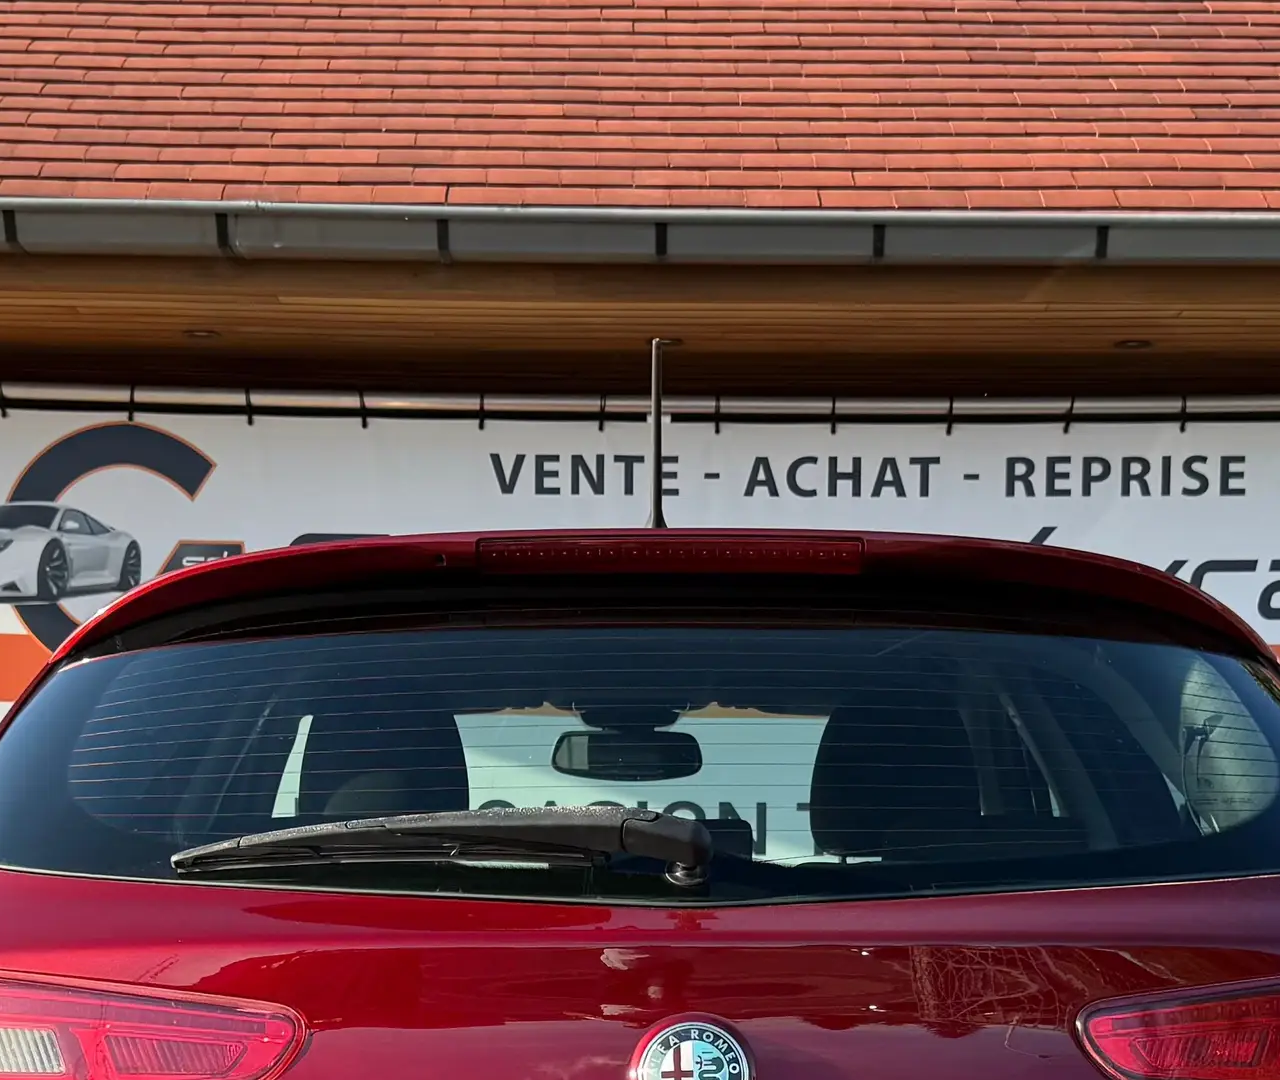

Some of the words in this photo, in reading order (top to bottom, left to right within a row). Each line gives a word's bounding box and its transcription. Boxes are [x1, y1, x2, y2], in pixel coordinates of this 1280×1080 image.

[489, 453, 679, 496] VENTE
[743, 456, 941, 498] ACHAT
[1005, 455, 1246, 497] REPRISE
[690, 1029, 741, 1075] ROMEO
